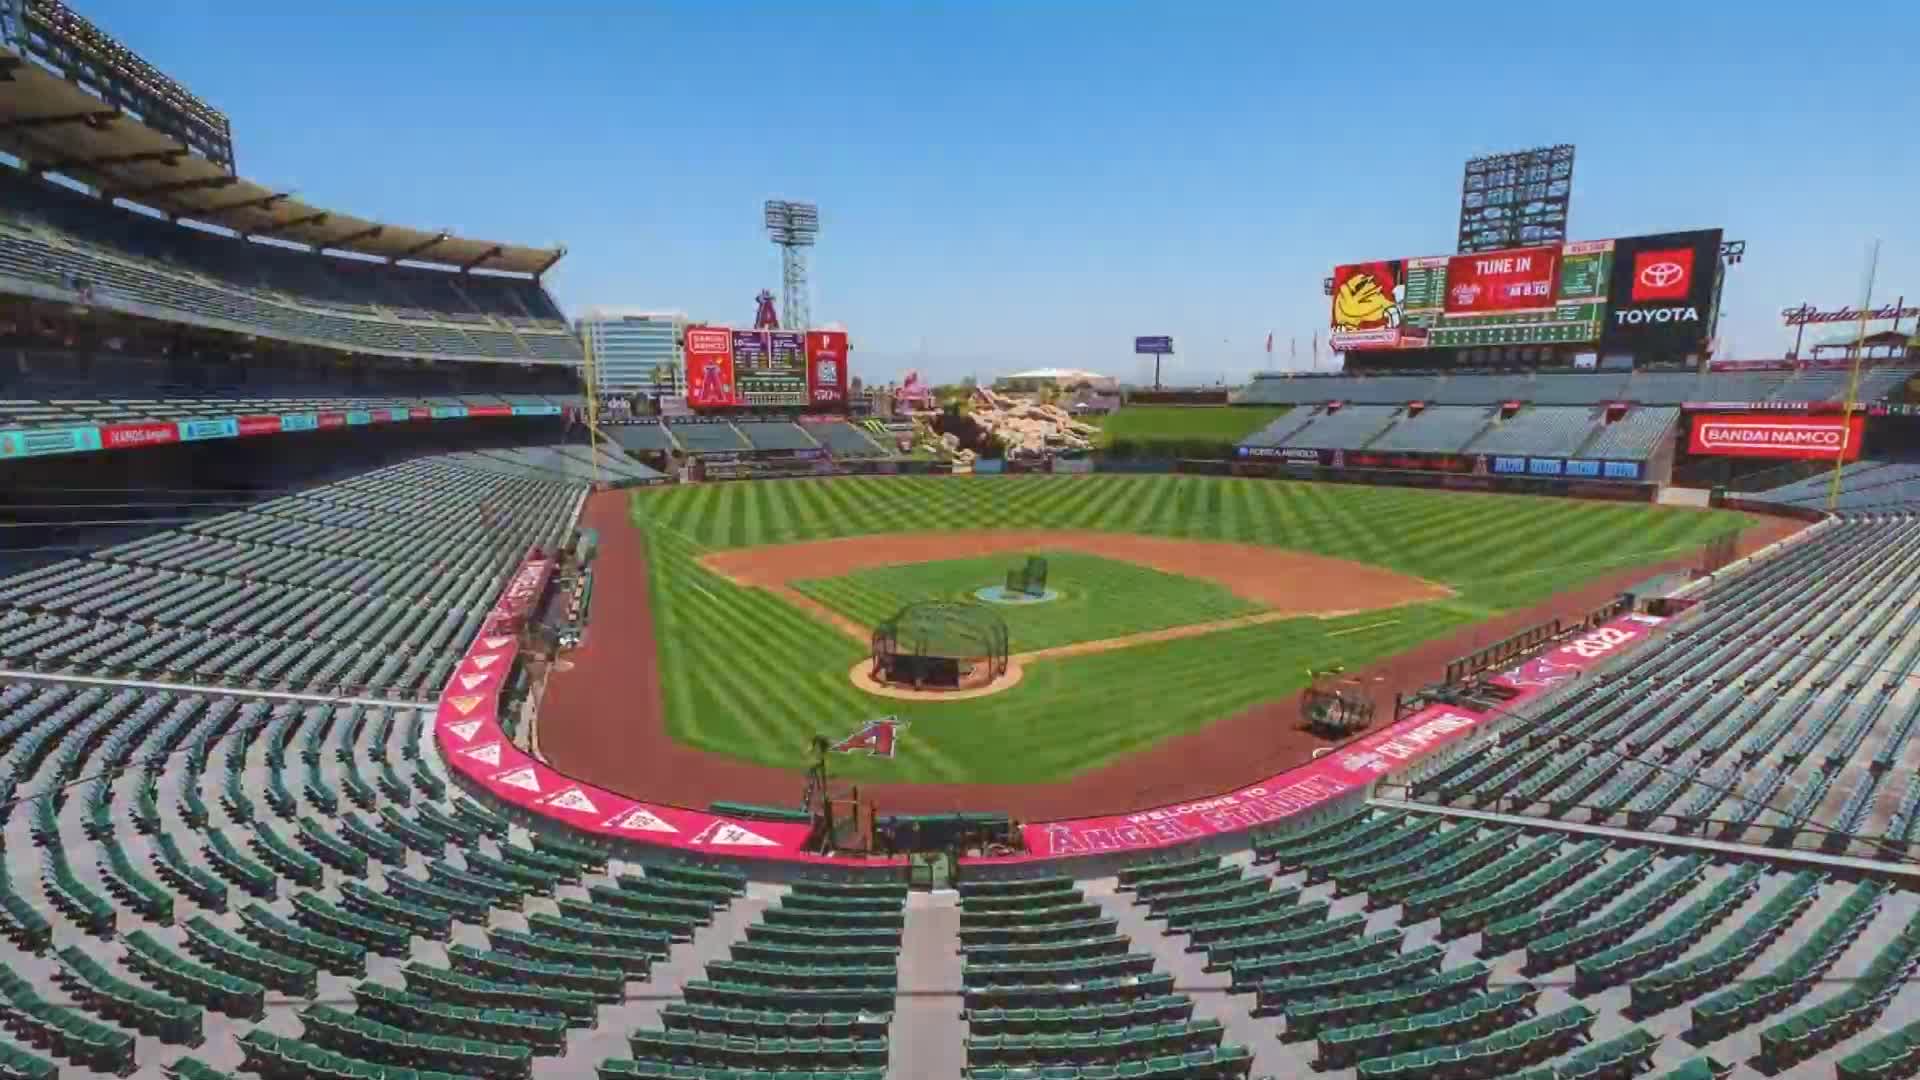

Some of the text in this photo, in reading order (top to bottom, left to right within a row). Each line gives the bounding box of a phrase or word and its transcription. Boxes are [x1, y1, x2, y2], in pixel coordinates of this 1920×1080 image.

[1475, 256, 1532, 276] TUNE IN
[1616, 307, 1699, 325] TOYOTA
[1708, 428, 1840, 443] BANDAI NAMCO
[1127, 787, 1267, 825] WELCOME TO
[1049, 815, 1201, 854] ANGEL
